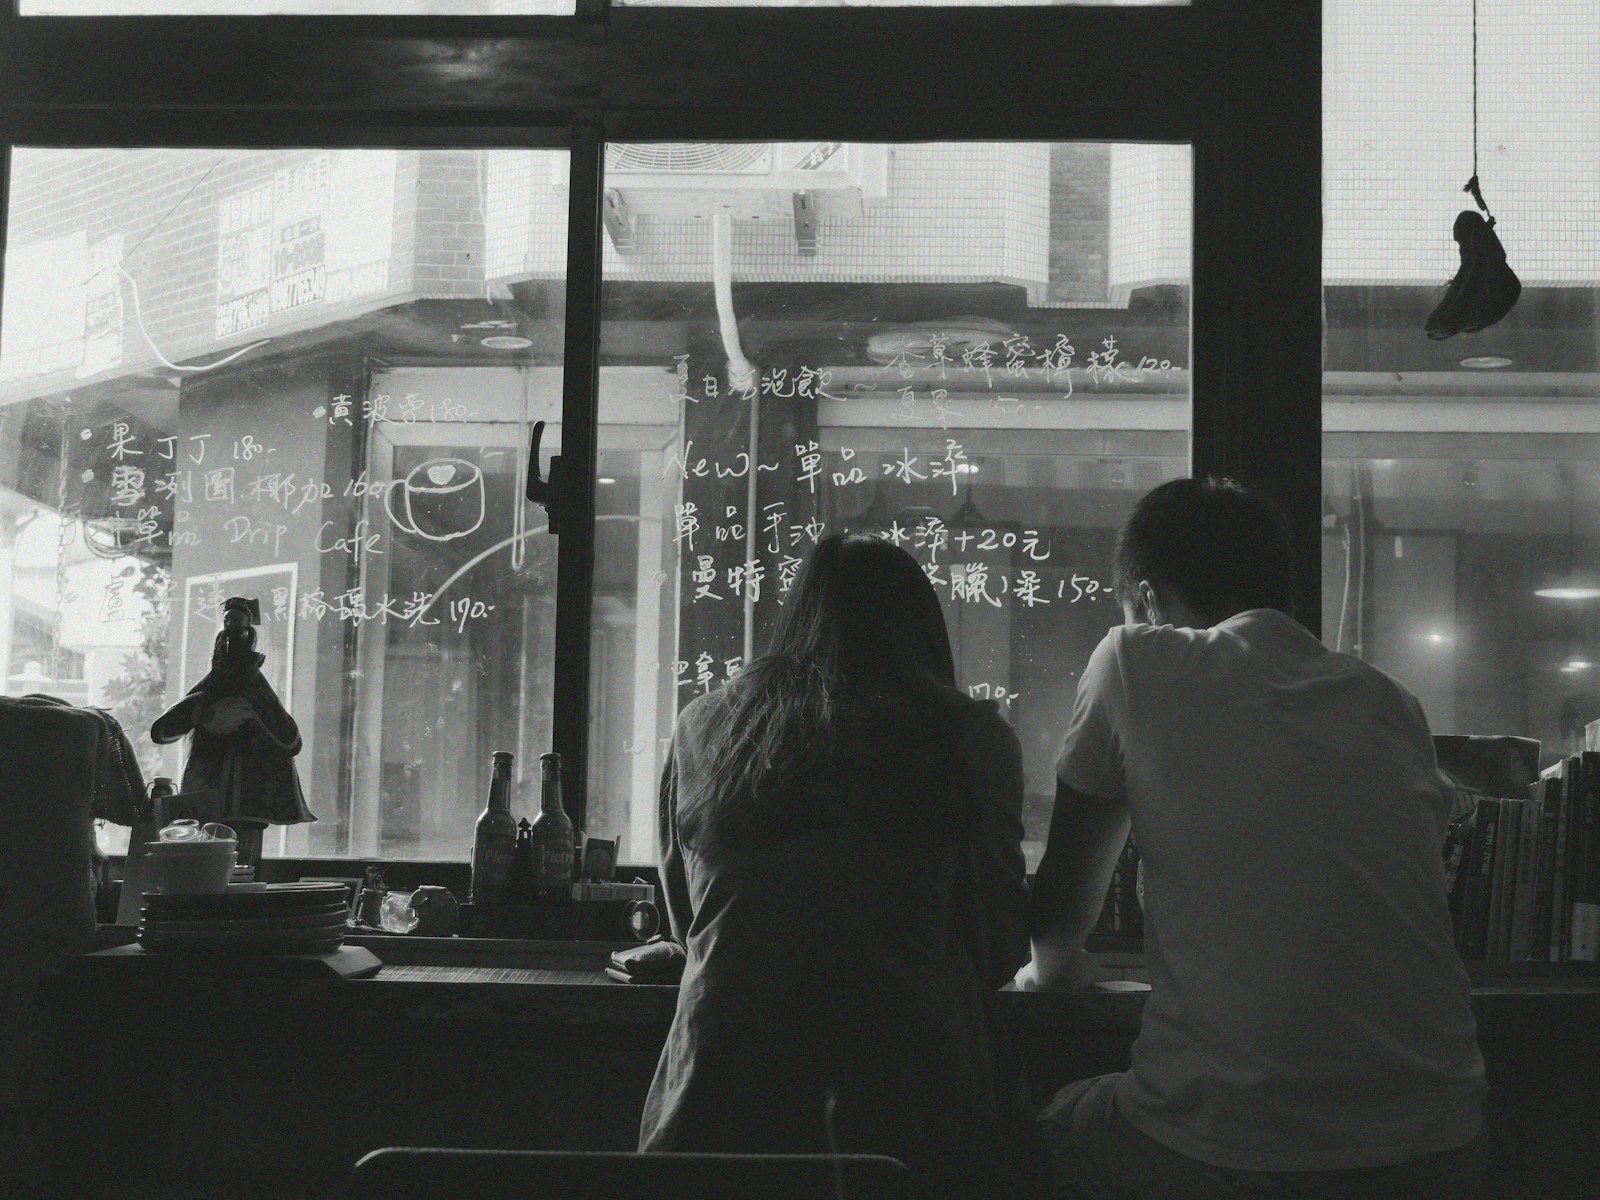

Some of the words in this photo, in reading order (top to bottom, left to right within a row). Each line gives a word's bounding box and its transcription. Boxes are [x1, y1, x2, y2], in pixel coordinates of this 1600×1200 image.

[106, 422, 212, 465] 果丁丁
[223, 515, 289, 558] Drip
